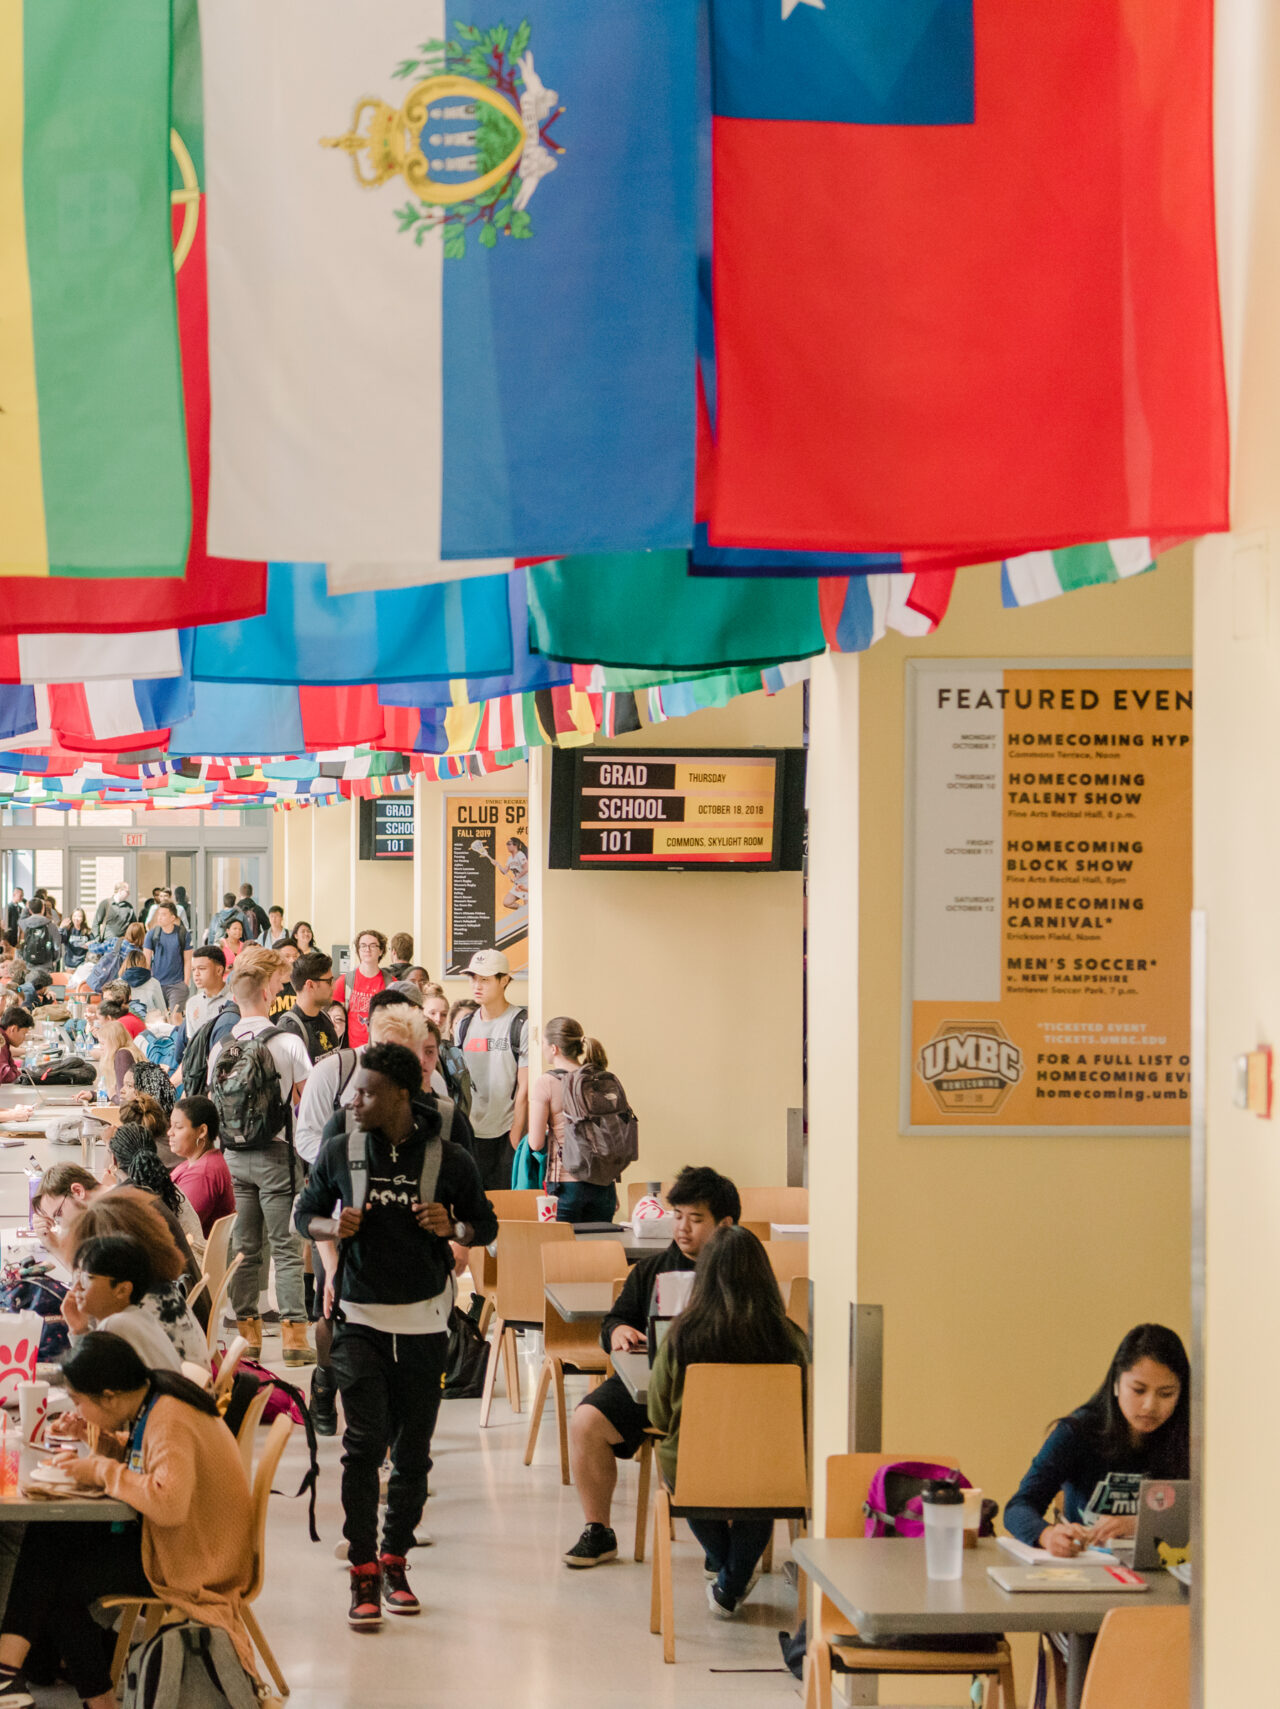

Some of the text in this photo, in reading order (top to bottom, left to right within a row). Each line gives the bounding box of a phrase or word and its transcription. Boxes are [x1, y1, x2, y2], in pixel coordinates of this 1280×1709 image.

[937, 689, 1100, 710] FEATURED
[1008, 733, 1191, 747] HOMECOMING HYP
[1008, 750, 1121, 760] Commons Terrace, Noon
[599, 764, 648, 786] GRAD
[689, 773, 726, 783] THURSDAY
[1009, 773, 1145, 787] HOMECOMING
[1008, 792, 1142, 806] TALENT SHOW
[386, 804, 411, 816] GRAD
[598, 798, 667, 819] SCHOOL
[698, 805, 730, 815] OCTOBER
[745, 805, 764, 815] 2018
[1008, 810, 1027, 818] Fine
[1030, 810, 1049, 818] Arts
[1051, 810, 1082, 818] Recital
[458, 806, 499, 824] CLUB
[457, 829, 491, 837] FALL 2019
[126, 834, 143, 846] EXIT
[387, 839, 404, 851] 101
[600, 831, 632, 851] 101
[666, 837, 764, 848] COMMONS, SKYLIGHT ROOM
[1007, 840, 1144, 854] HOMECOMING
[1007, 859, 1134, 873] BLOCK SHOW
[1028, 876, 1047, 884] Arts
[1007, 897, 1144, 911] HOMECOMING
[1007, 958, 1066, 970] MEN'S
[1022, 974, 1049, 983] NEW
[1054, 974, 1129, 984] HAMPSHIRE
[1107, 1023, 1147, 1032] EVENT
[922, 1034, 1019, 1083] UMBC
[1037, 1054, 1070, 1064] FOR
[1077, 1055, 1087, 1064] A
[1094, 1055, 1132, 1065] FULL
[1139, 1055, 1172, 1065] LIST
[1037, 1071, 1158, 1082] HOMECOMING
[1036, 1087, 1188, 1101] homecoming.umb
